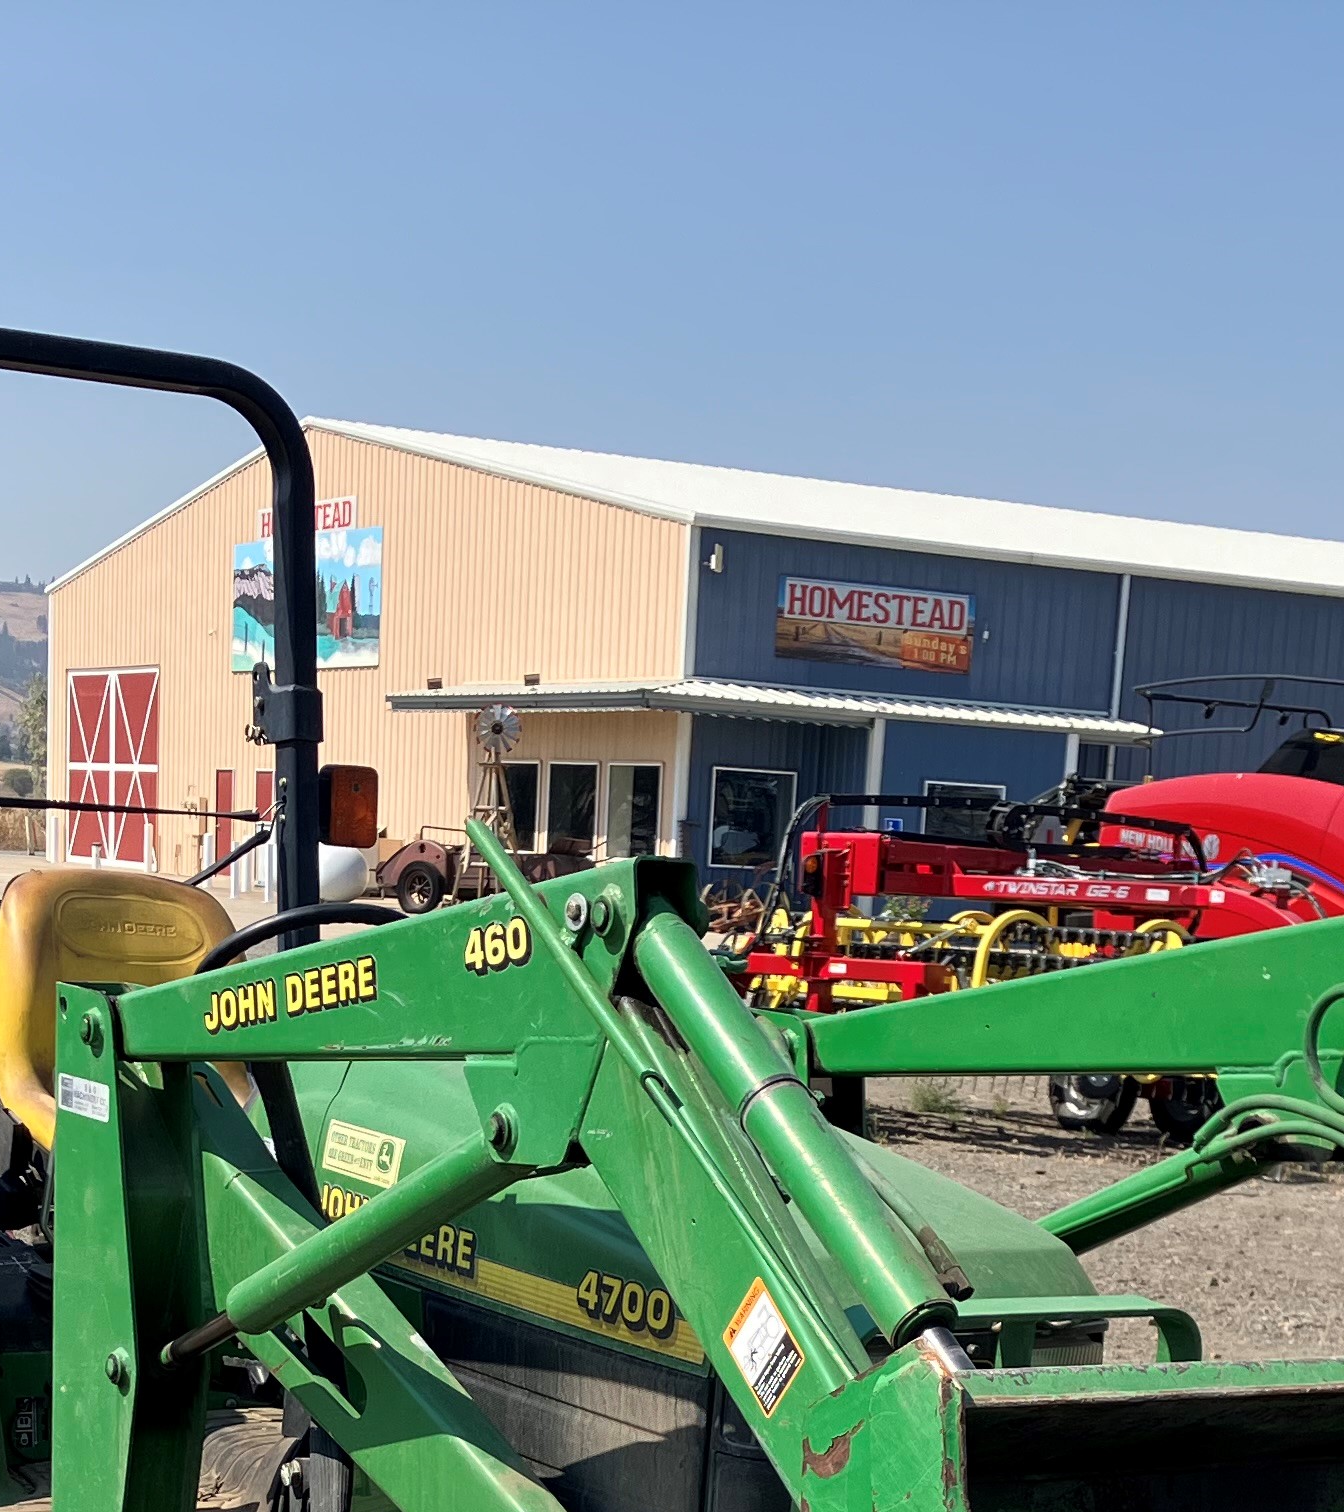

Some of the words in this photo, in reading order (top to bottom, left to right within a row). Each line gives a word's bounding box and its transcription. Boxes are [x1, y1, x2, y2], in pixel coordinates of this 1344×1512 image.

[261, 501, 352, 538] HTEAD
[787, 583, 966, 631] HOMESTEAD
[940, 652, 957, 666] PM
[1119, 829, 1146, 846] NEW
[998, 880, 1080, 897] TWINSTAR
[1086, 886, 1130, 899] G2-6
[464, 915, 531, 976] 460
[204, 978, 277, 1034] JOHN
[285, 955, 377, 1017] DEERE
[576, 1270, 675, 1339] 4700
[735, 1287, 760, 1327] WARNING
